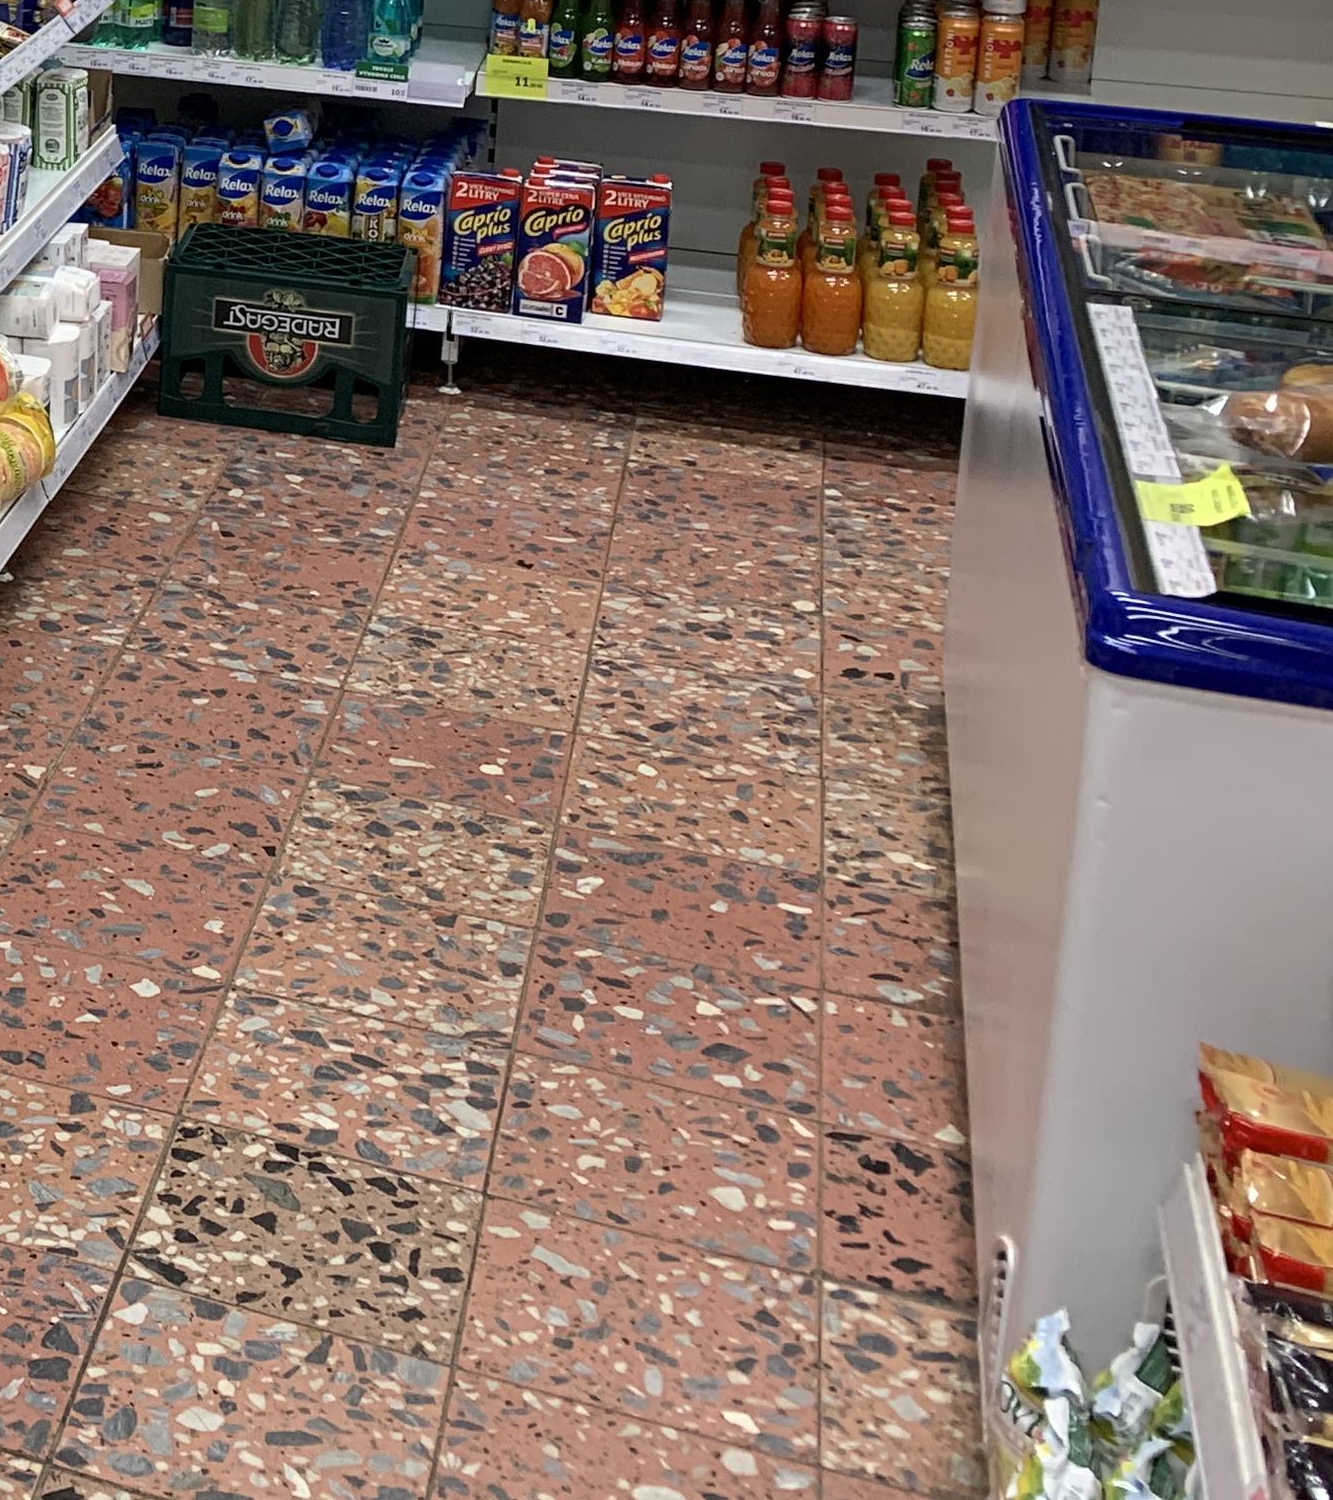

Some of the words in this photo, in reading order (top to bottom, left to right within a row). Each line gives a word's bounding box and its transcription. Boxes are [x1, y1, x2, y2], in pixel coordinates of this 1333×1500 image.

[828, 51, 853, 63] Relax
[515, 76, 529, 87] 11
[139, 162, 172, 178] Relax
[185, 168, 217, 181] Relax
[221, 178, 255, 193] Relax
[265, 185, 299, 199] Relax
[455, 181, 469, 198] 2
[469, 188, 499, 201] LITRY
[309, 190, 343, 205] Relax
[357, 193, 391, 208] Relax
[527, 190, 538, 203] 2
[604, 190, 617, 205] 2
[618, 197, 649, 209] LITRY
[404, 199, 438, 215] Relax
[453, 205, 511, 235] Caprio
[524, 205, 584, 236] Caprio
[603, 213, 661, 243] Caprio
[476, 221, 511, 243] plus
[627, 229, 661, 250] plus
[555, 306, 564, 317] C
[223, 306, 340, 339] RADEGAST
